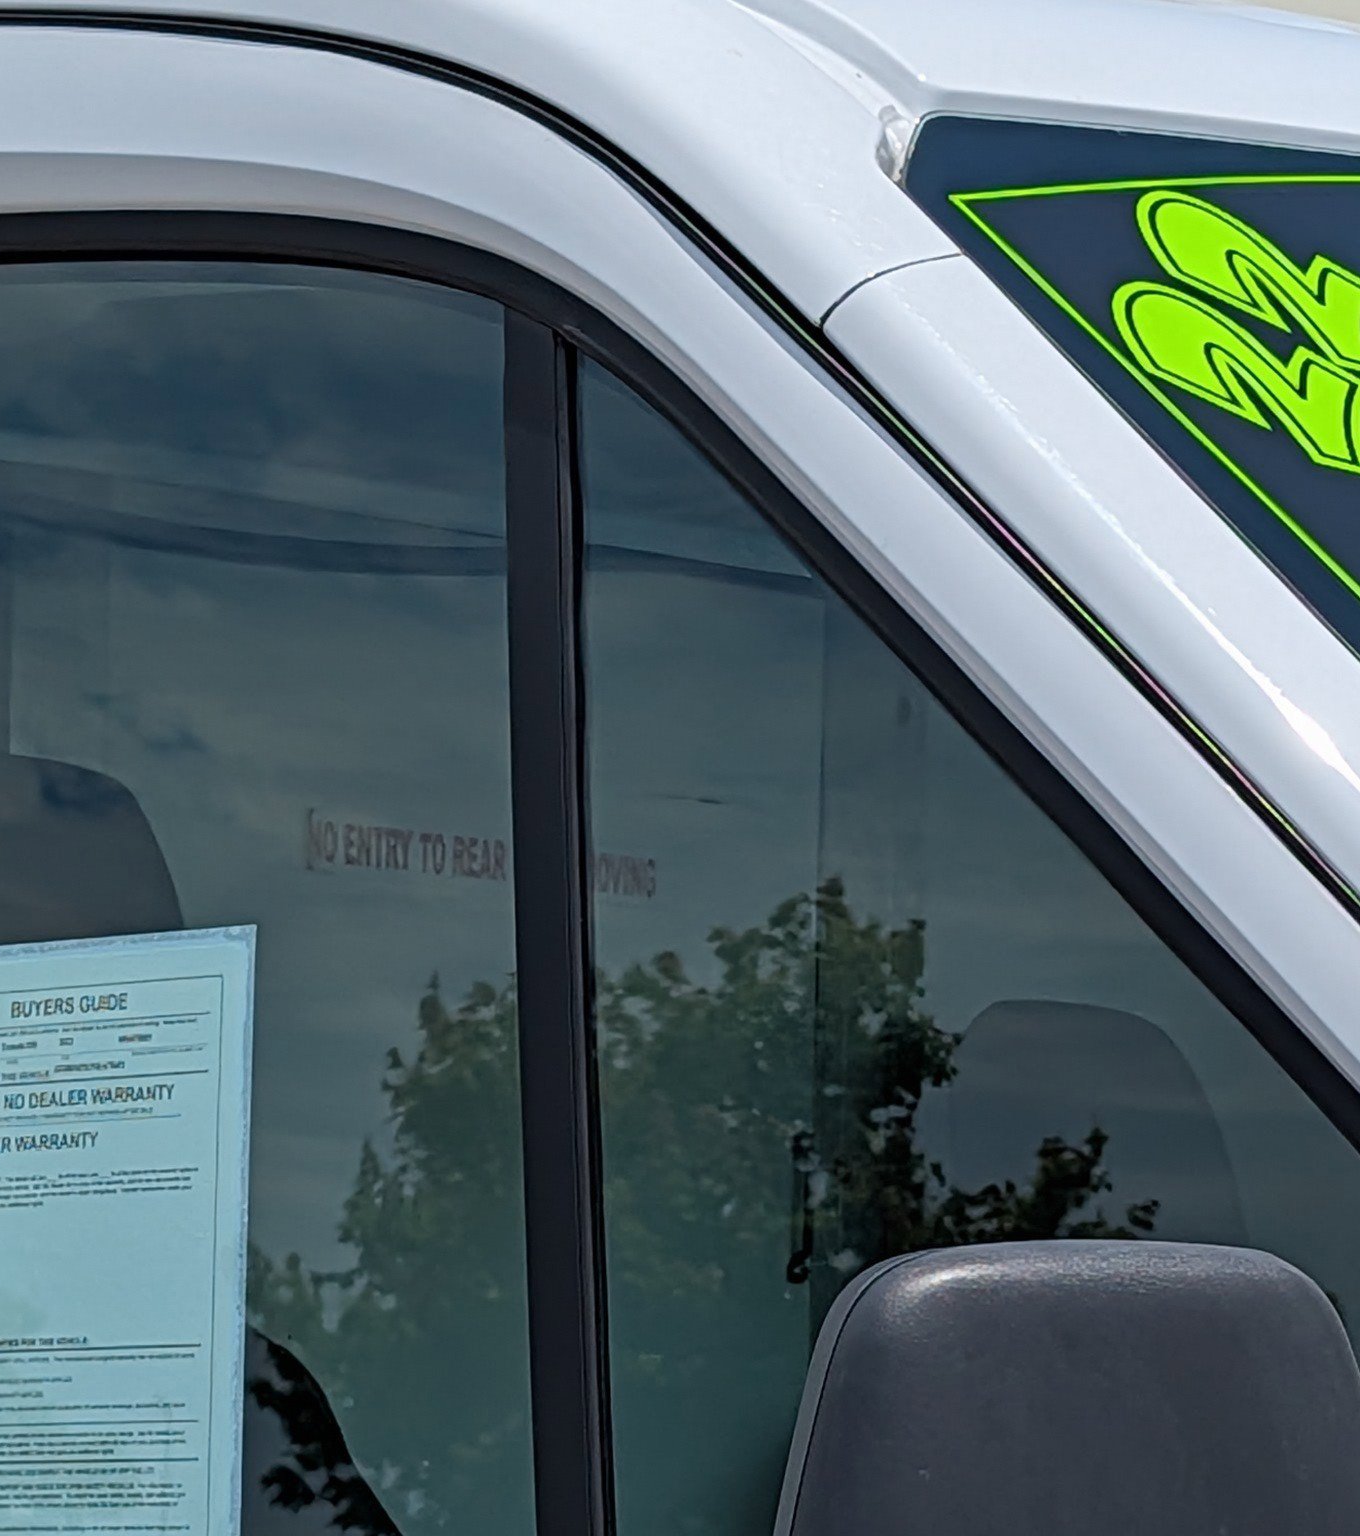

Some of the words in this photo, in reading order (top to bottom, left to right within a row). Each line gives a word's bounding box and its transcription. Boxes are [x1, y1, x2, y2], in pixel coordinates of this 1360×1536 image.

[344, 823, 413, 871] ENTRY
[418, 831, 446, 876] TO
[452, 834, 507, 882] REAR
[10, 996, 75, 1019] BUYERS
[78, 993, 128, 1014] GUIDE
[3, 1092, 25, 1110] NO
[28, 1088, 88, 1109] DEALER
[90, 1083, 176, 1105] WARRANTY
[14, 1131, 99, 1153] WARRANTY
